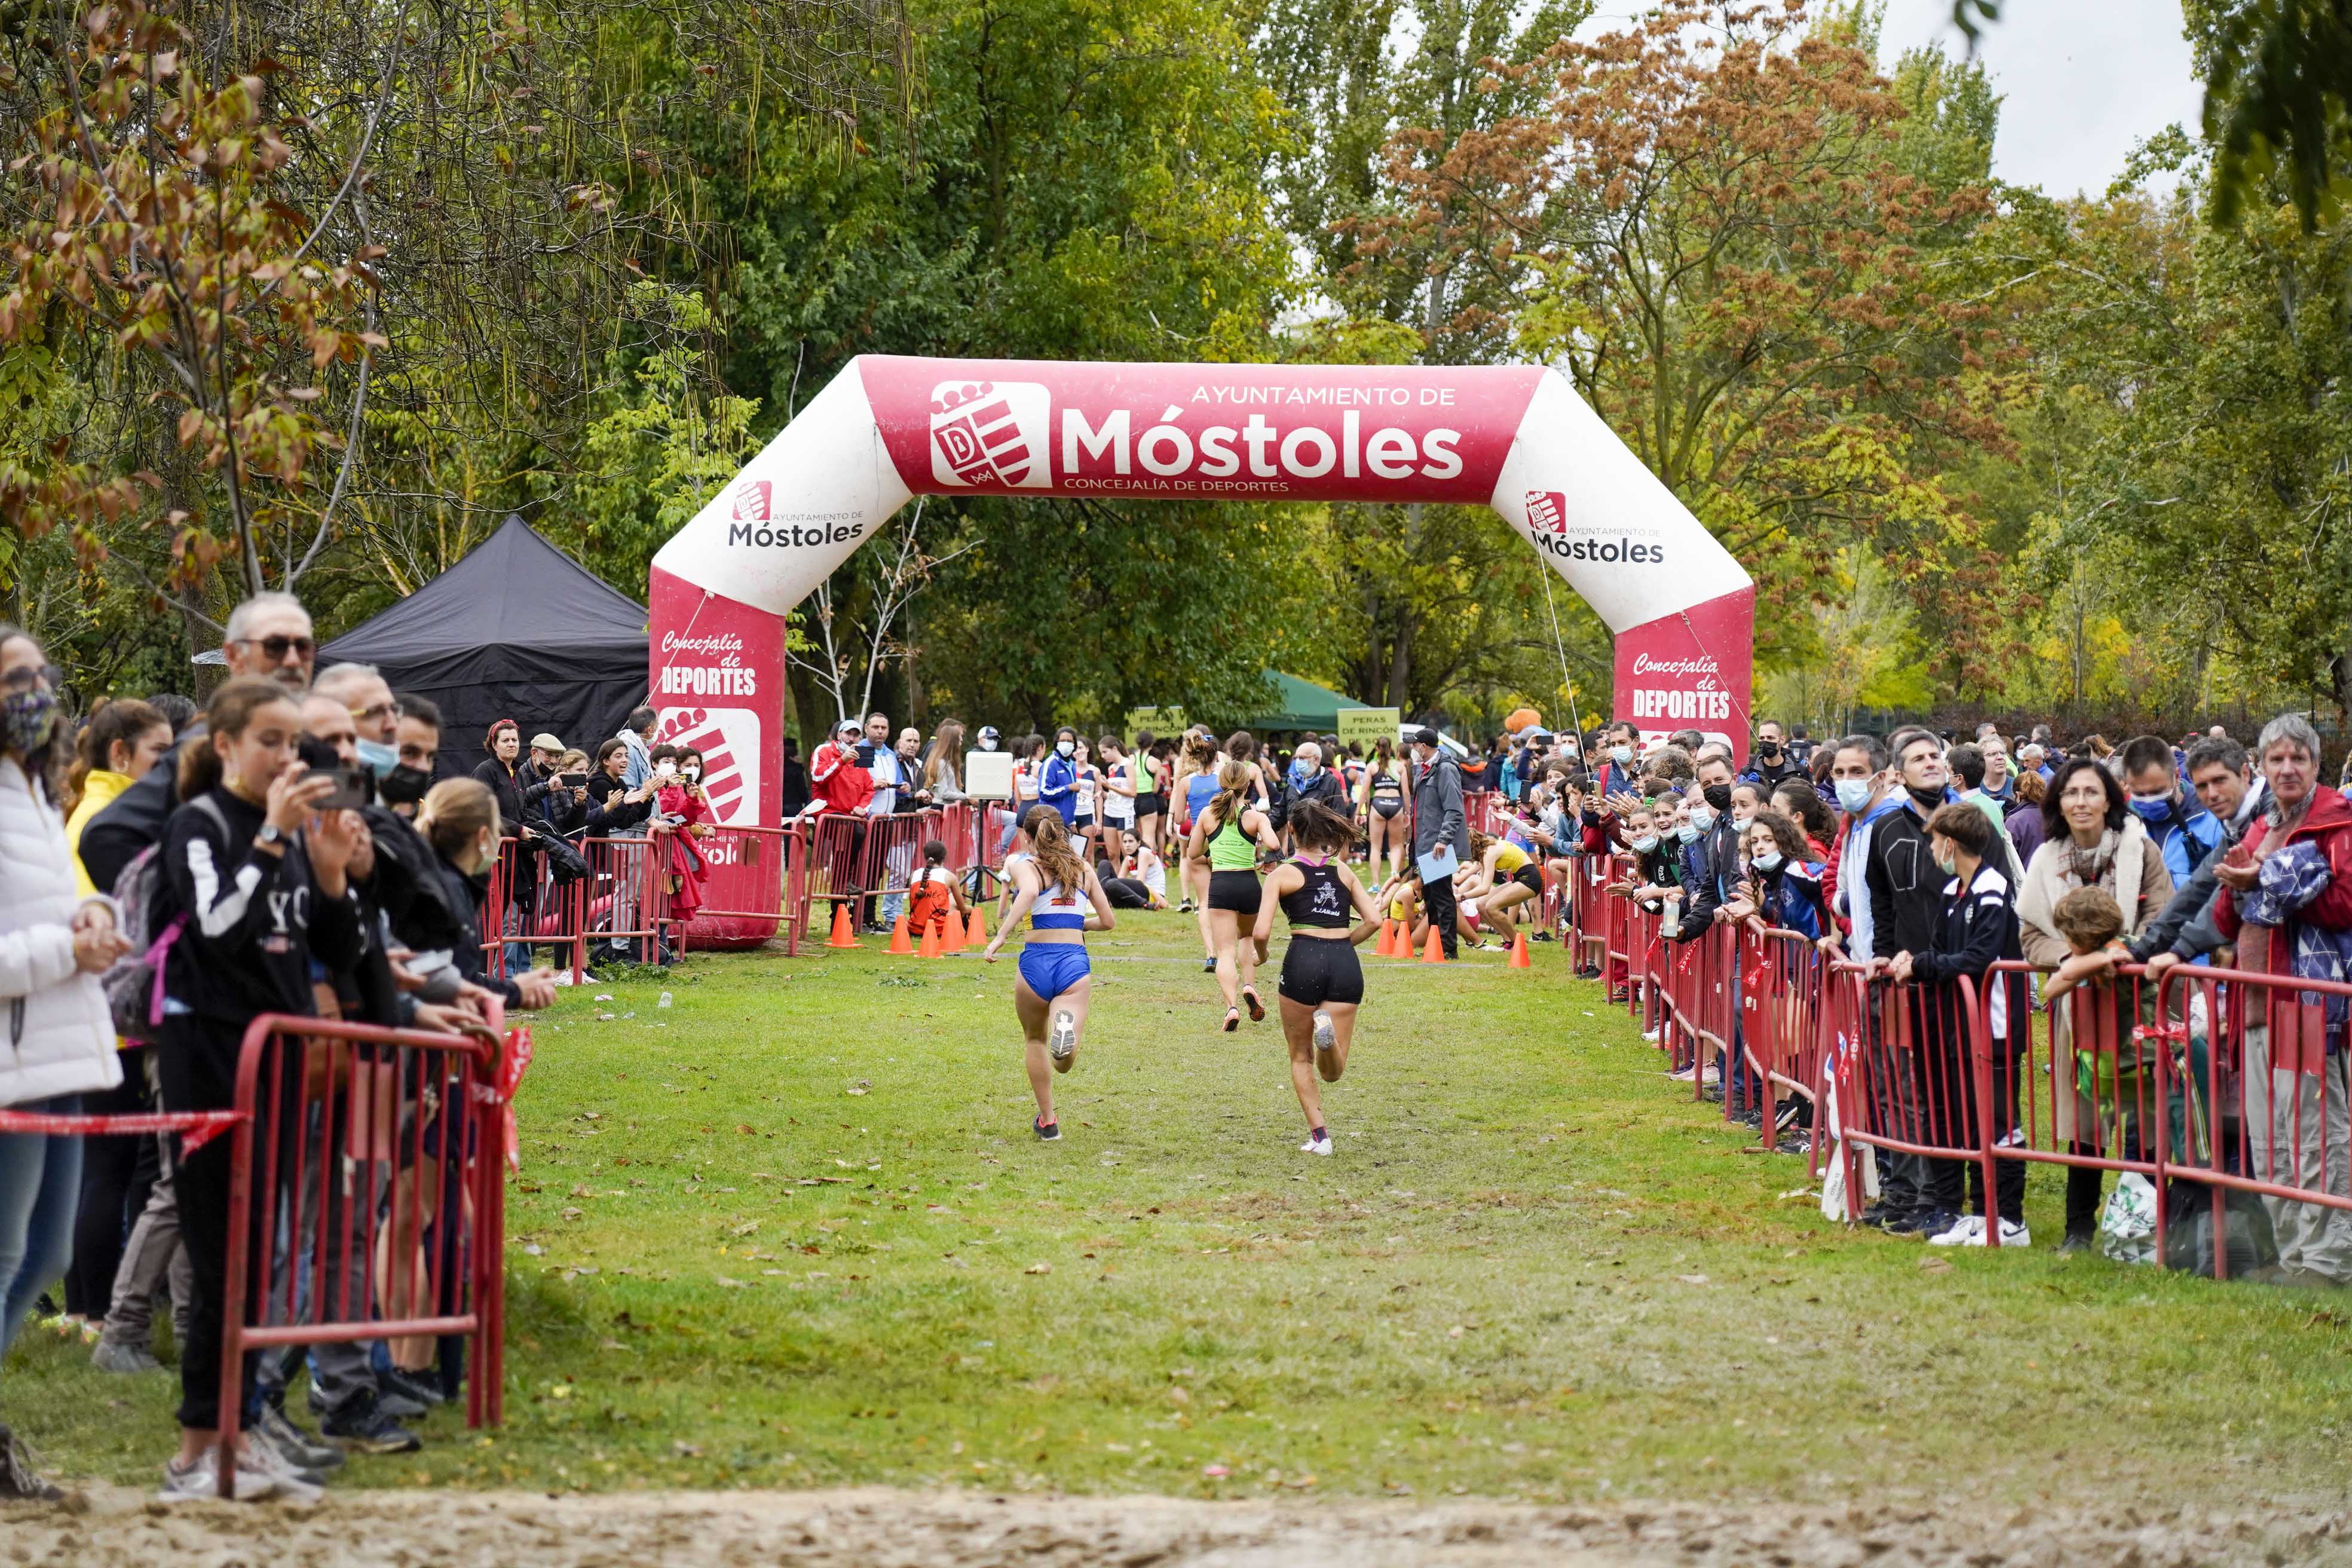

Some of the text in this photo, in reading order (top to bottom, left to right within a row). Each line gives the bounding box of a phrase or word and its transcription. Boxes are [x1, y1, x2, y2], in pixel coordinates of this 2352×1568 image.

[1191, 386, 1456, 406] AYUNTAMIENTO DE
[1062, 403, 1463, 479] Móstoles
[1064, 477, 1289, 492] CONCEJALÍA DE DEPORTES
[773, 512, 849, 522] AYUNTAMIENTO
[728, 522, 863, 547] Móstoles
[1569, 526, 1646, 537] AYUNTAMIENTO
[1532, 530, 1664, 564] Móstoles
[662, 630, 743, 656] Concejalía
[720, 651, 741, 667] de
[1633, 653, 1719, 679] Concejalía
[662, 666, 756, 696] DEPORTES
[1696, 674, 1716, 691] de
[1633, 689, 1729, 719] DEPORTES
[1359, 725, 1396, 734] RINCÓN
